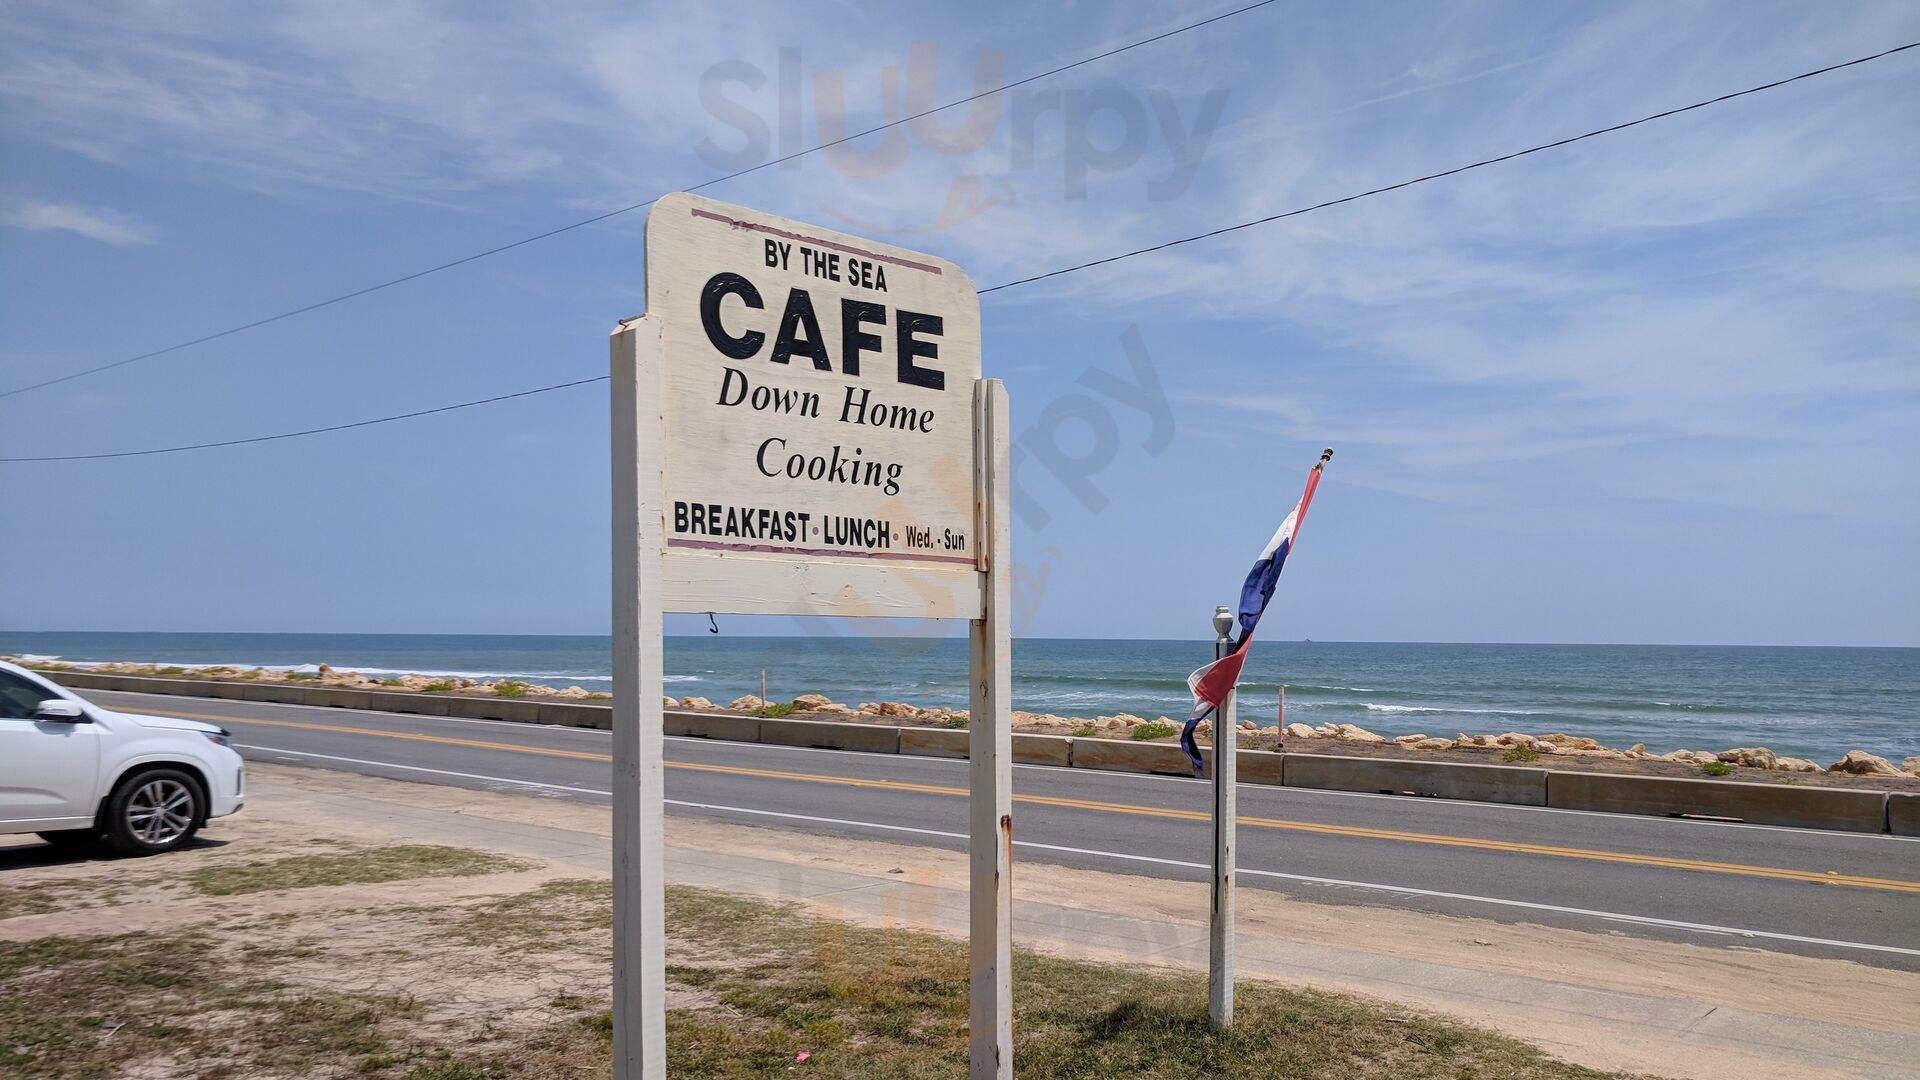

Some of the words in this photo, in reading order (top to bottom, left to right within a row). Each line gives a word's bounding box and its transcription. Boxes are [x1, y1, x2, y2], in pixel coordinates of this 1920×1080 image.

[764, 238, 792, 271] BY
[799, 246, 841, 283] THE
[847, 257, 888, 293] SEA
[699, 271, 945, 391] CAFE
[715, 366, 820, 419] Down
[838, 385, 935, 434] Home
[756, 437, 904, 496] Cooking
[674, 500, 811, 543] BREAKFAST
[823, 515, 890, 549] LUNCH
[944, 527, 965, 551] Sun
